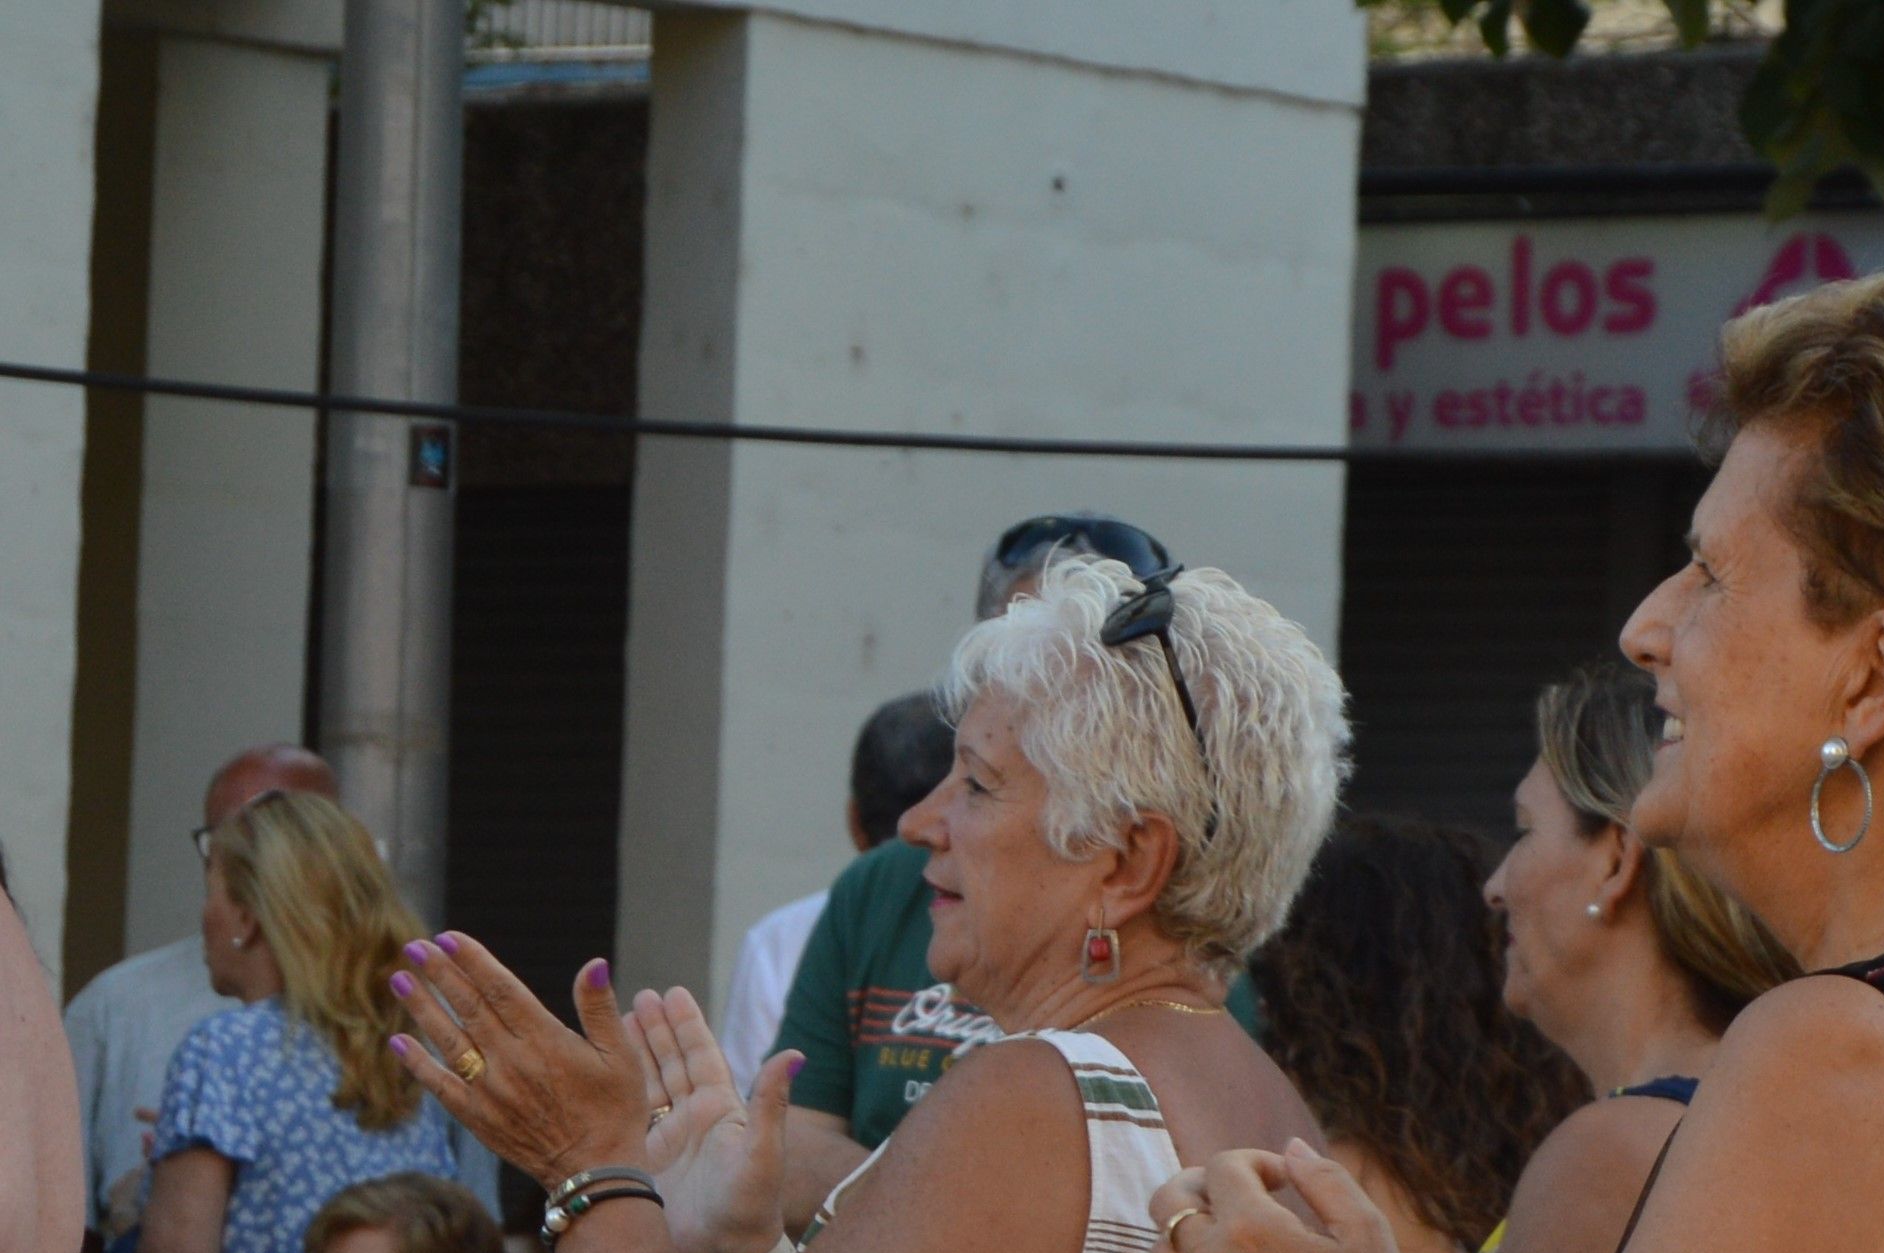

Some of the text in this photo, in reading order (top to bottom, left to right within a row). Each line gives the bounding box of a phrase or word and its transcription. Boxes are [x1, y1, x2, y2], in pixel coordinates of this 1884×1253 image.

[1375, 234, 1658, 370] pelos
[1387, 389, 1414, 442] y
[1432, 368, 1648, 428] estética
